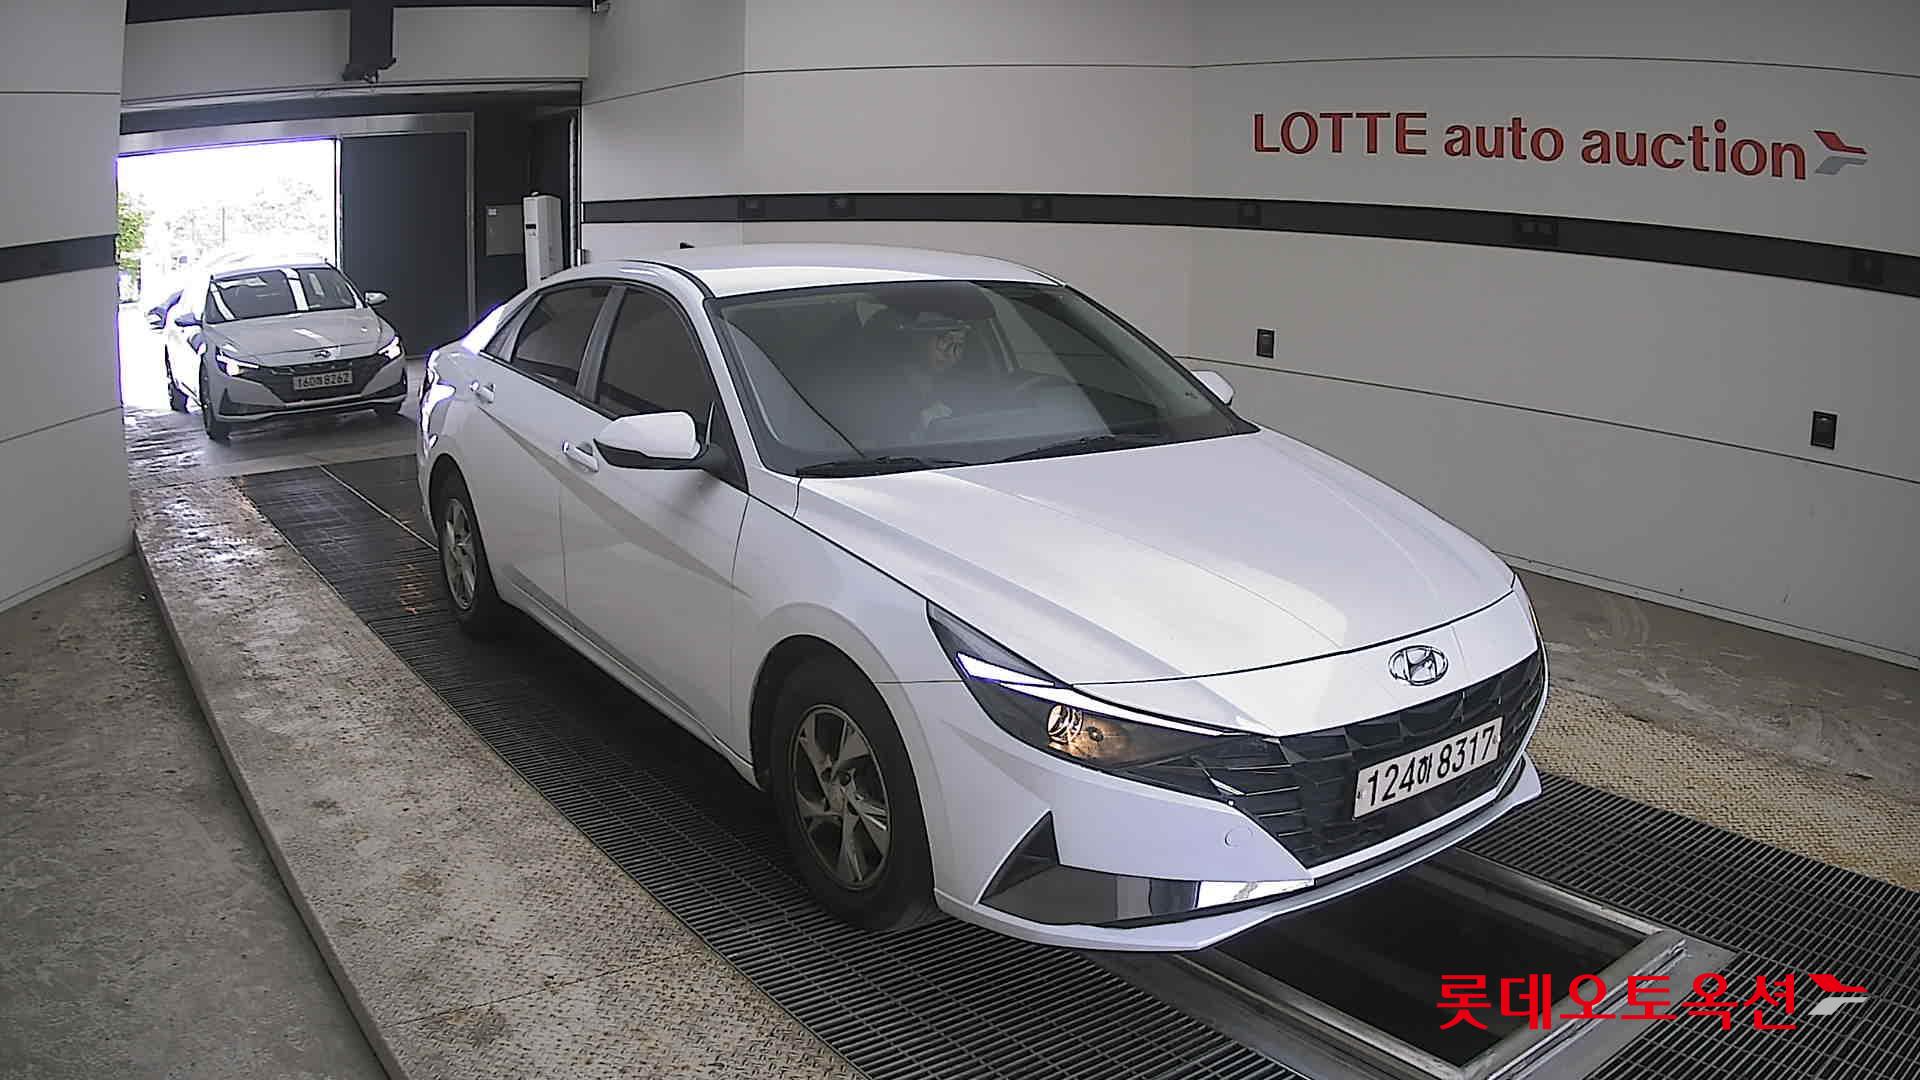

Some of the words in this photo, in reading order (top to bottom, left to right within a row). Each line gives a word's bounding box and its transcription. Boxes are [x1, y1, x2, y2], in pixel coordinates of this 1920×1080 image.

[1254, 111, 1428, 155] LOTTE
[1443, 117, 1565, 162] auto
[1581, 119, 1806, 180] auction
